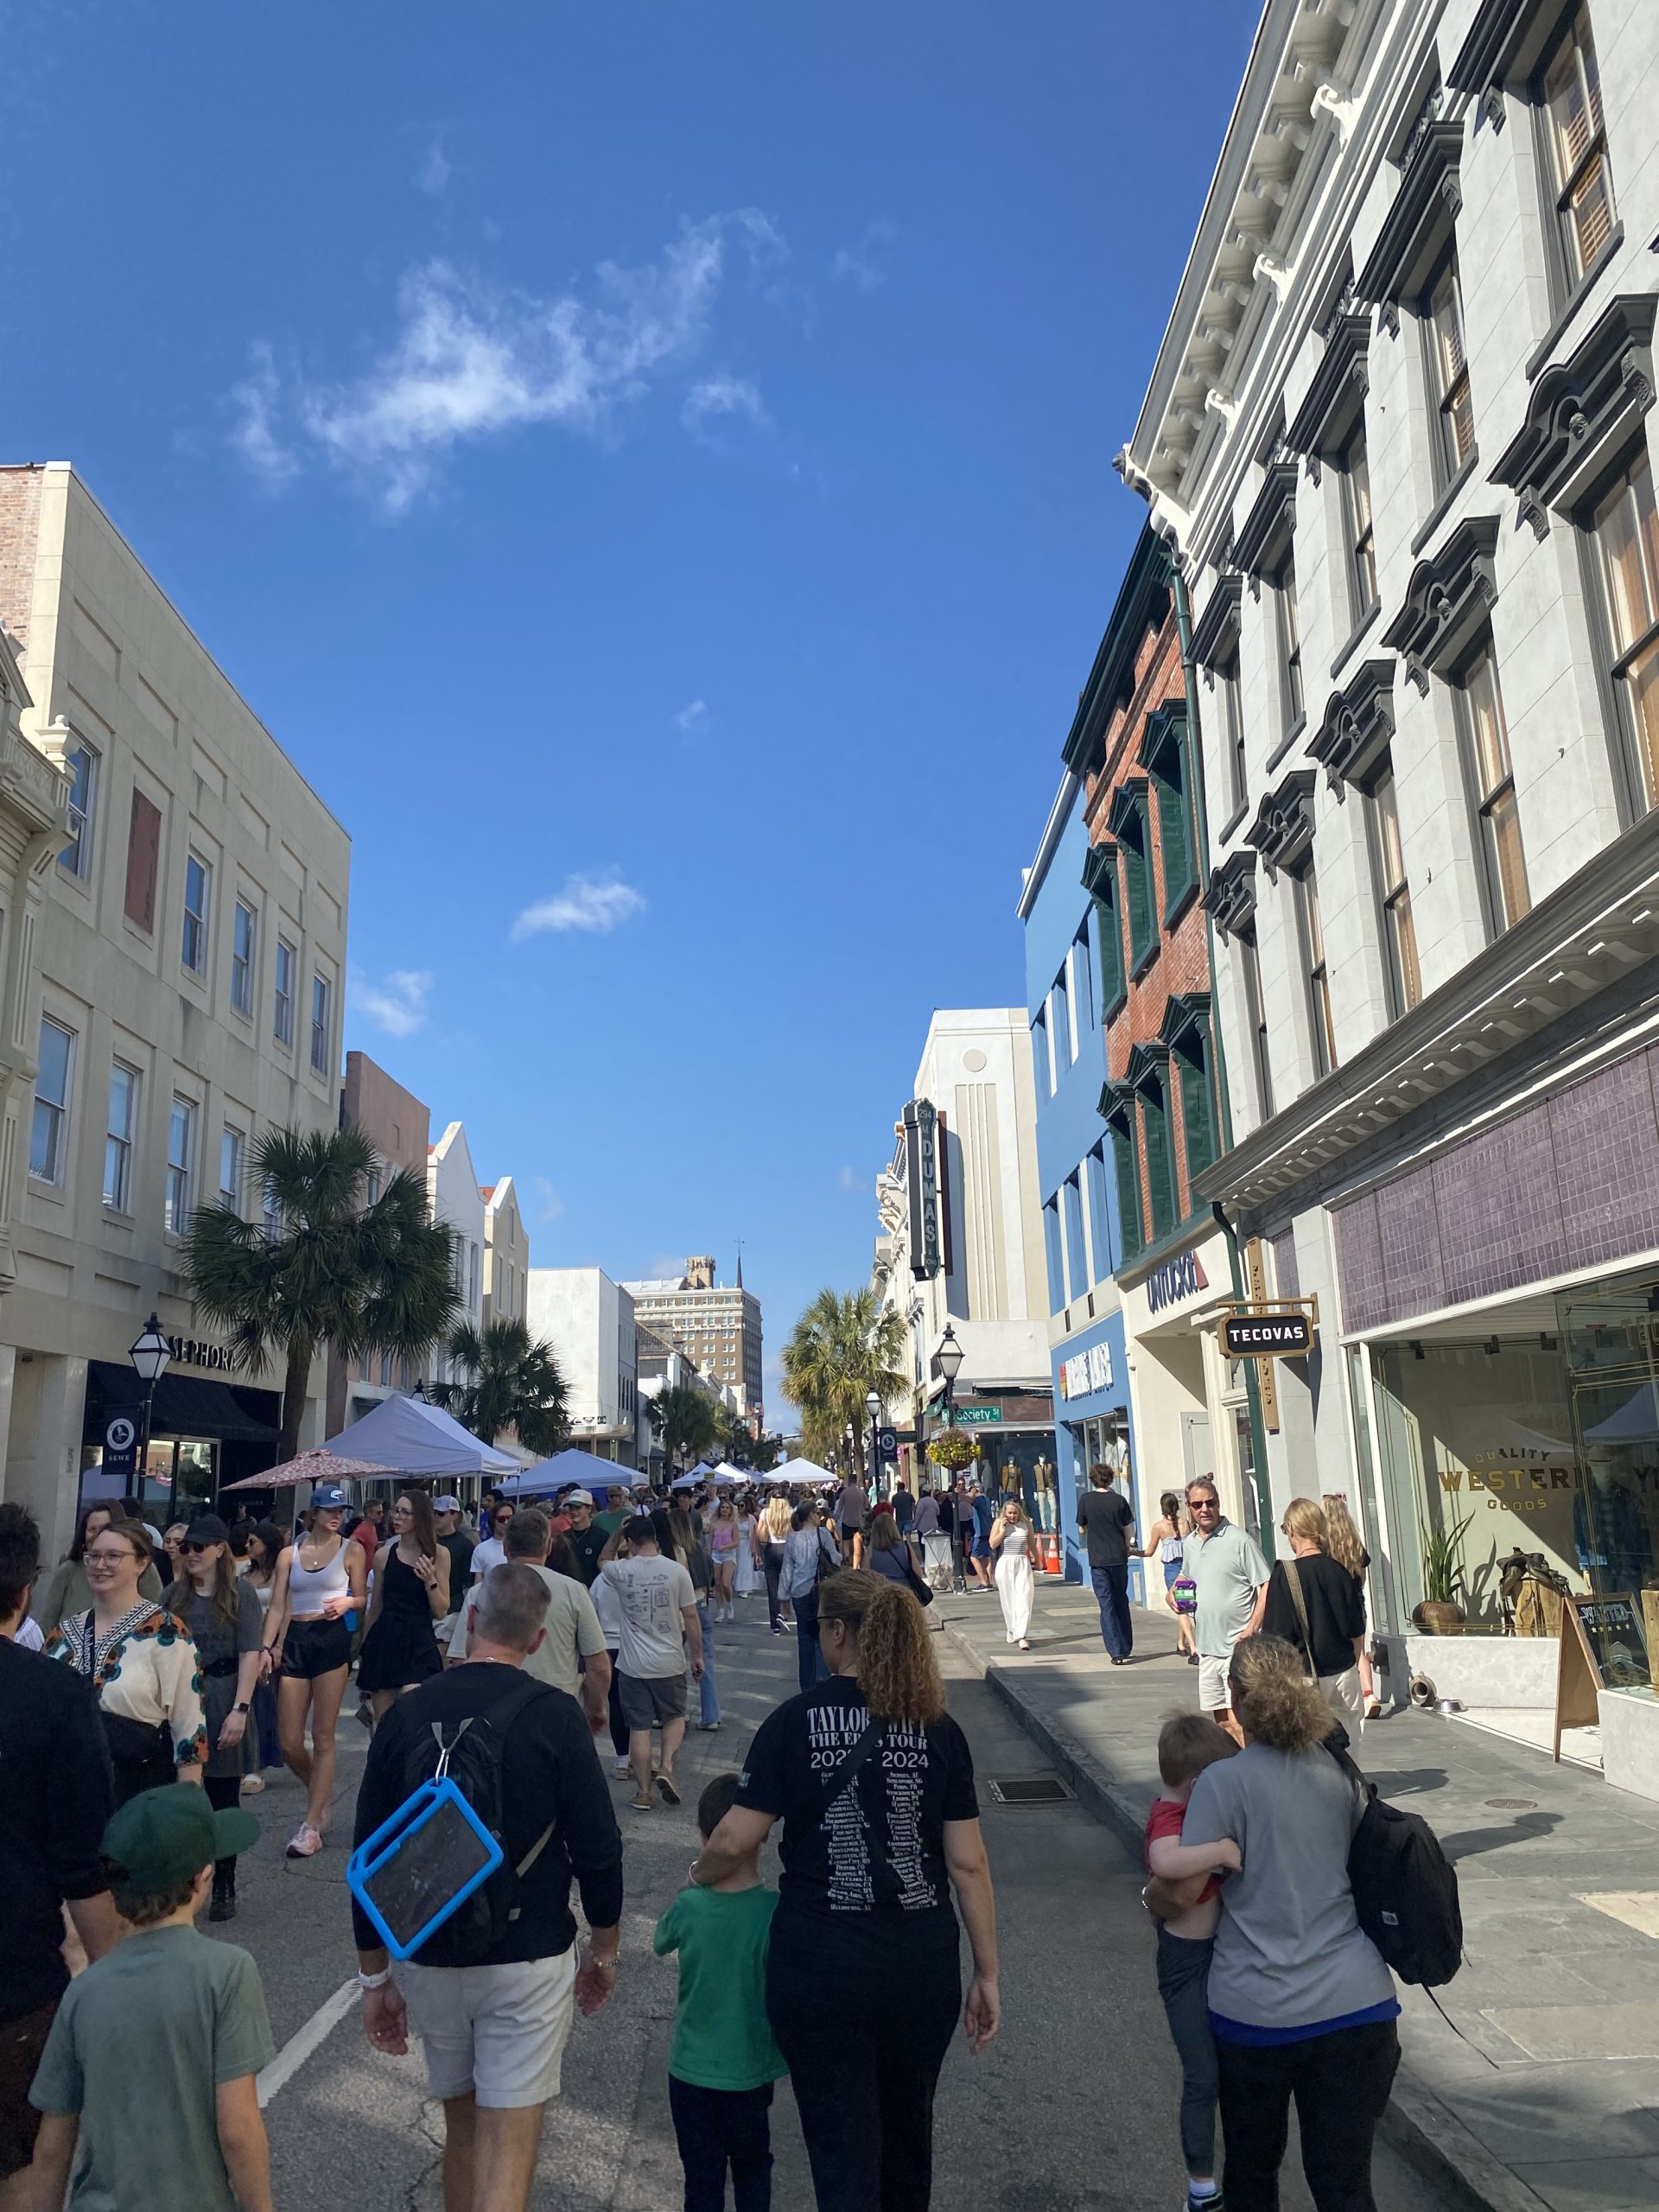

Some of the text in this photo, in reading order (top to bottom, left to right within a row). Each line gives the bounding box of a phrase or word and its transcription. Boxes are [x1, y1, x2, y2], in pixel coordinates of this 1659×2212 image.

[918, 1109, 932, 1119] 294
[922, 1140, 936, 1243] DUMAS
[1230, 1325, 1304, 1343] TECOVAS
[957, 1408, 990, 1421] Society
[1474, 1447, 1552, 1464] QUALITY
[1487, 1498, 1548, 1511] GOODS
[808, 1732, 840, 1748] THE
[887, 1733, 928, 1751] TOUR
[881, 1751, 930, 1769] 2024
